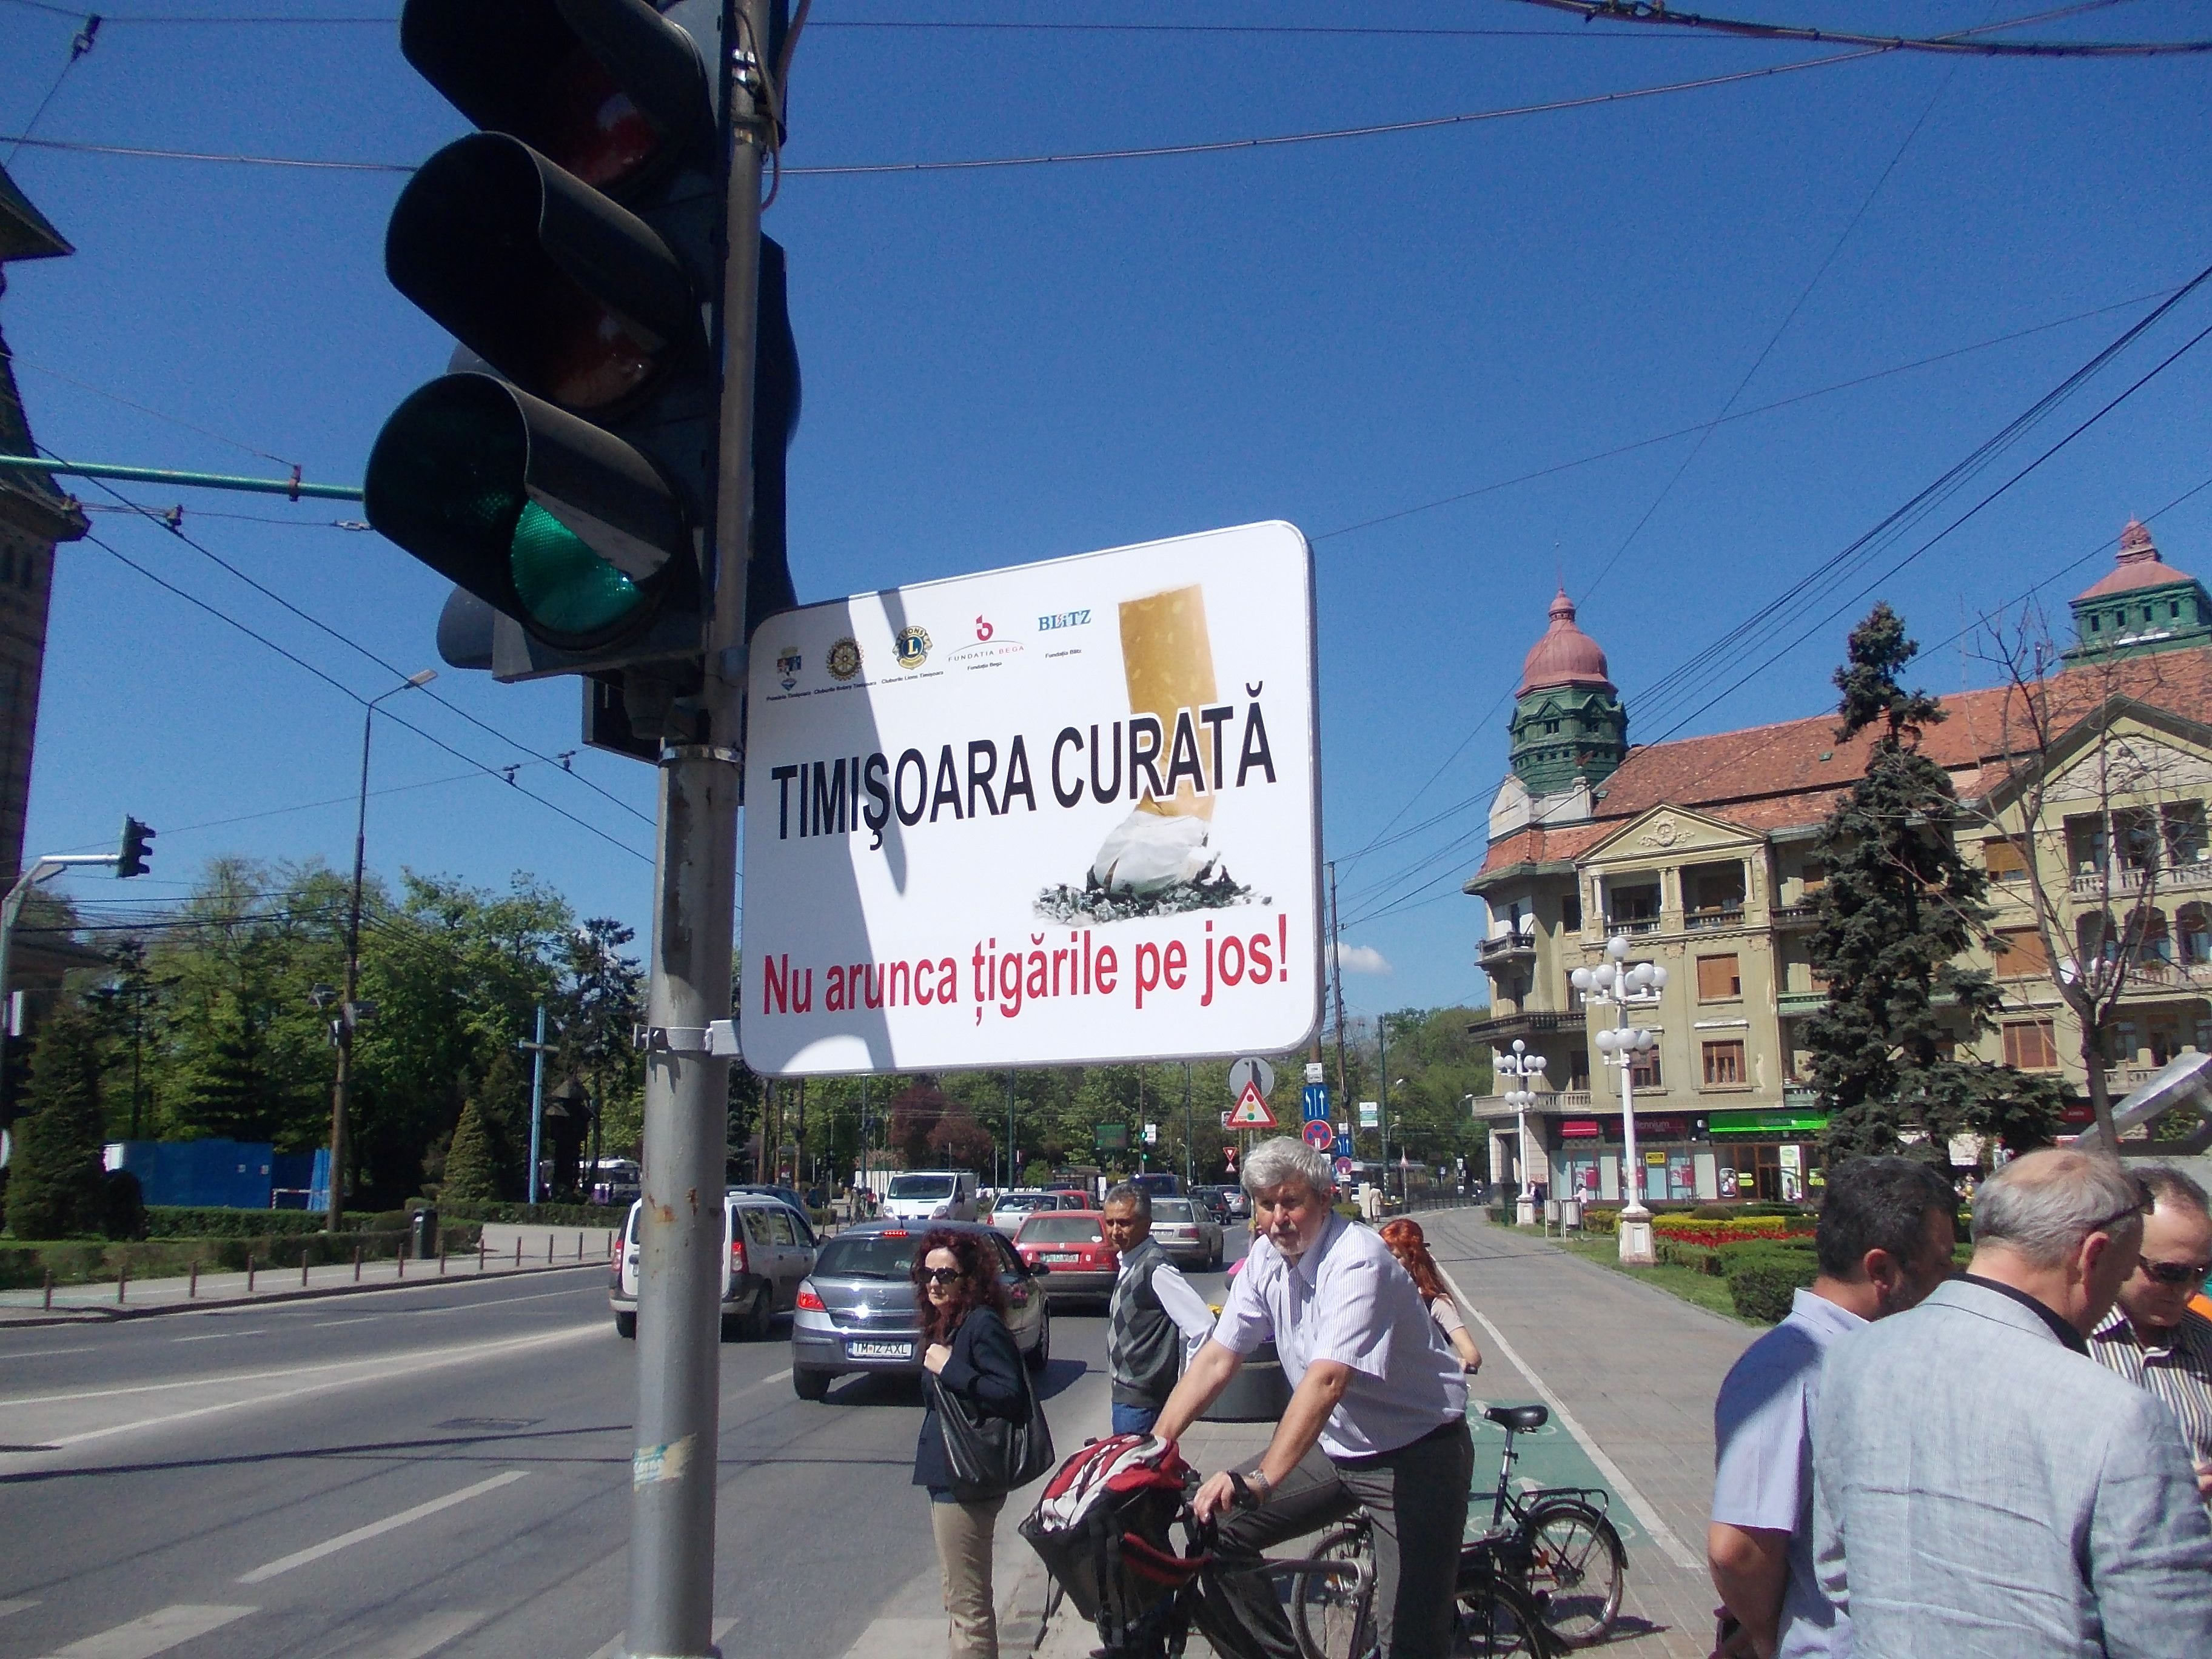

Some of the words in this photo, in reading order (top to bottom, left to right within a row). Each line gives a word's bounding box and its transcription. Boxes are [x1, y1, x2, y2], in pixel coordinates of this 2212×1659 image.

[900, 626, 924, 637] LIONS
[908, 639, 918, 655] L
[999, 646, 1024, 654] BEGA
[1051, 680, 1277, 809] CURATĂ
[763, 953, 813, 1015] Nu
[825, 957, 957, 1011] arunca
[972, 930, 1118, 1027] țigările
[1135, 940, 1188, 1010] pe
[1200, 913, 1288, 1007] jos!
[885, 1342, 907, 1355] AXL
